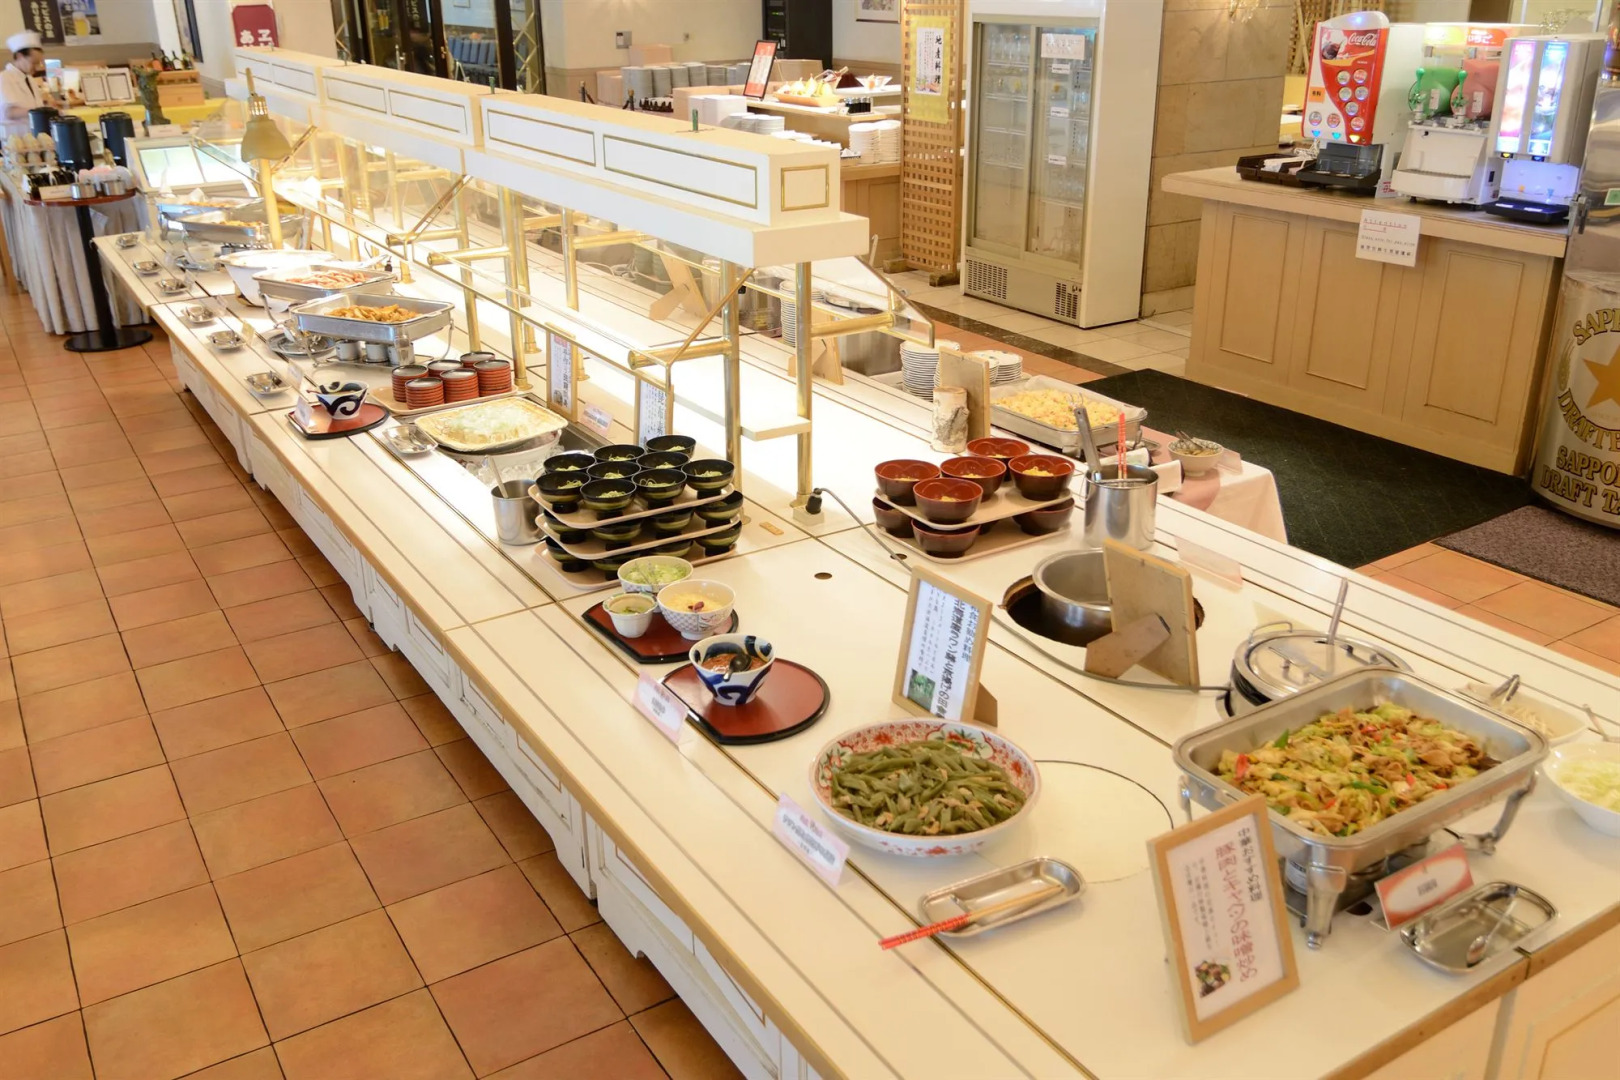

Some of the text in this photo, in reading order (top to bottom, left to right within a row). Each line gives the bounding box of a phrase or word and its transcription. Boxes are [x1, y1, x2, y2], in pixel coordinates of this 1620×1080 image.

[240, 29, 255, 47] あ
[1540, 464, 1620, 515] DRAFT T
